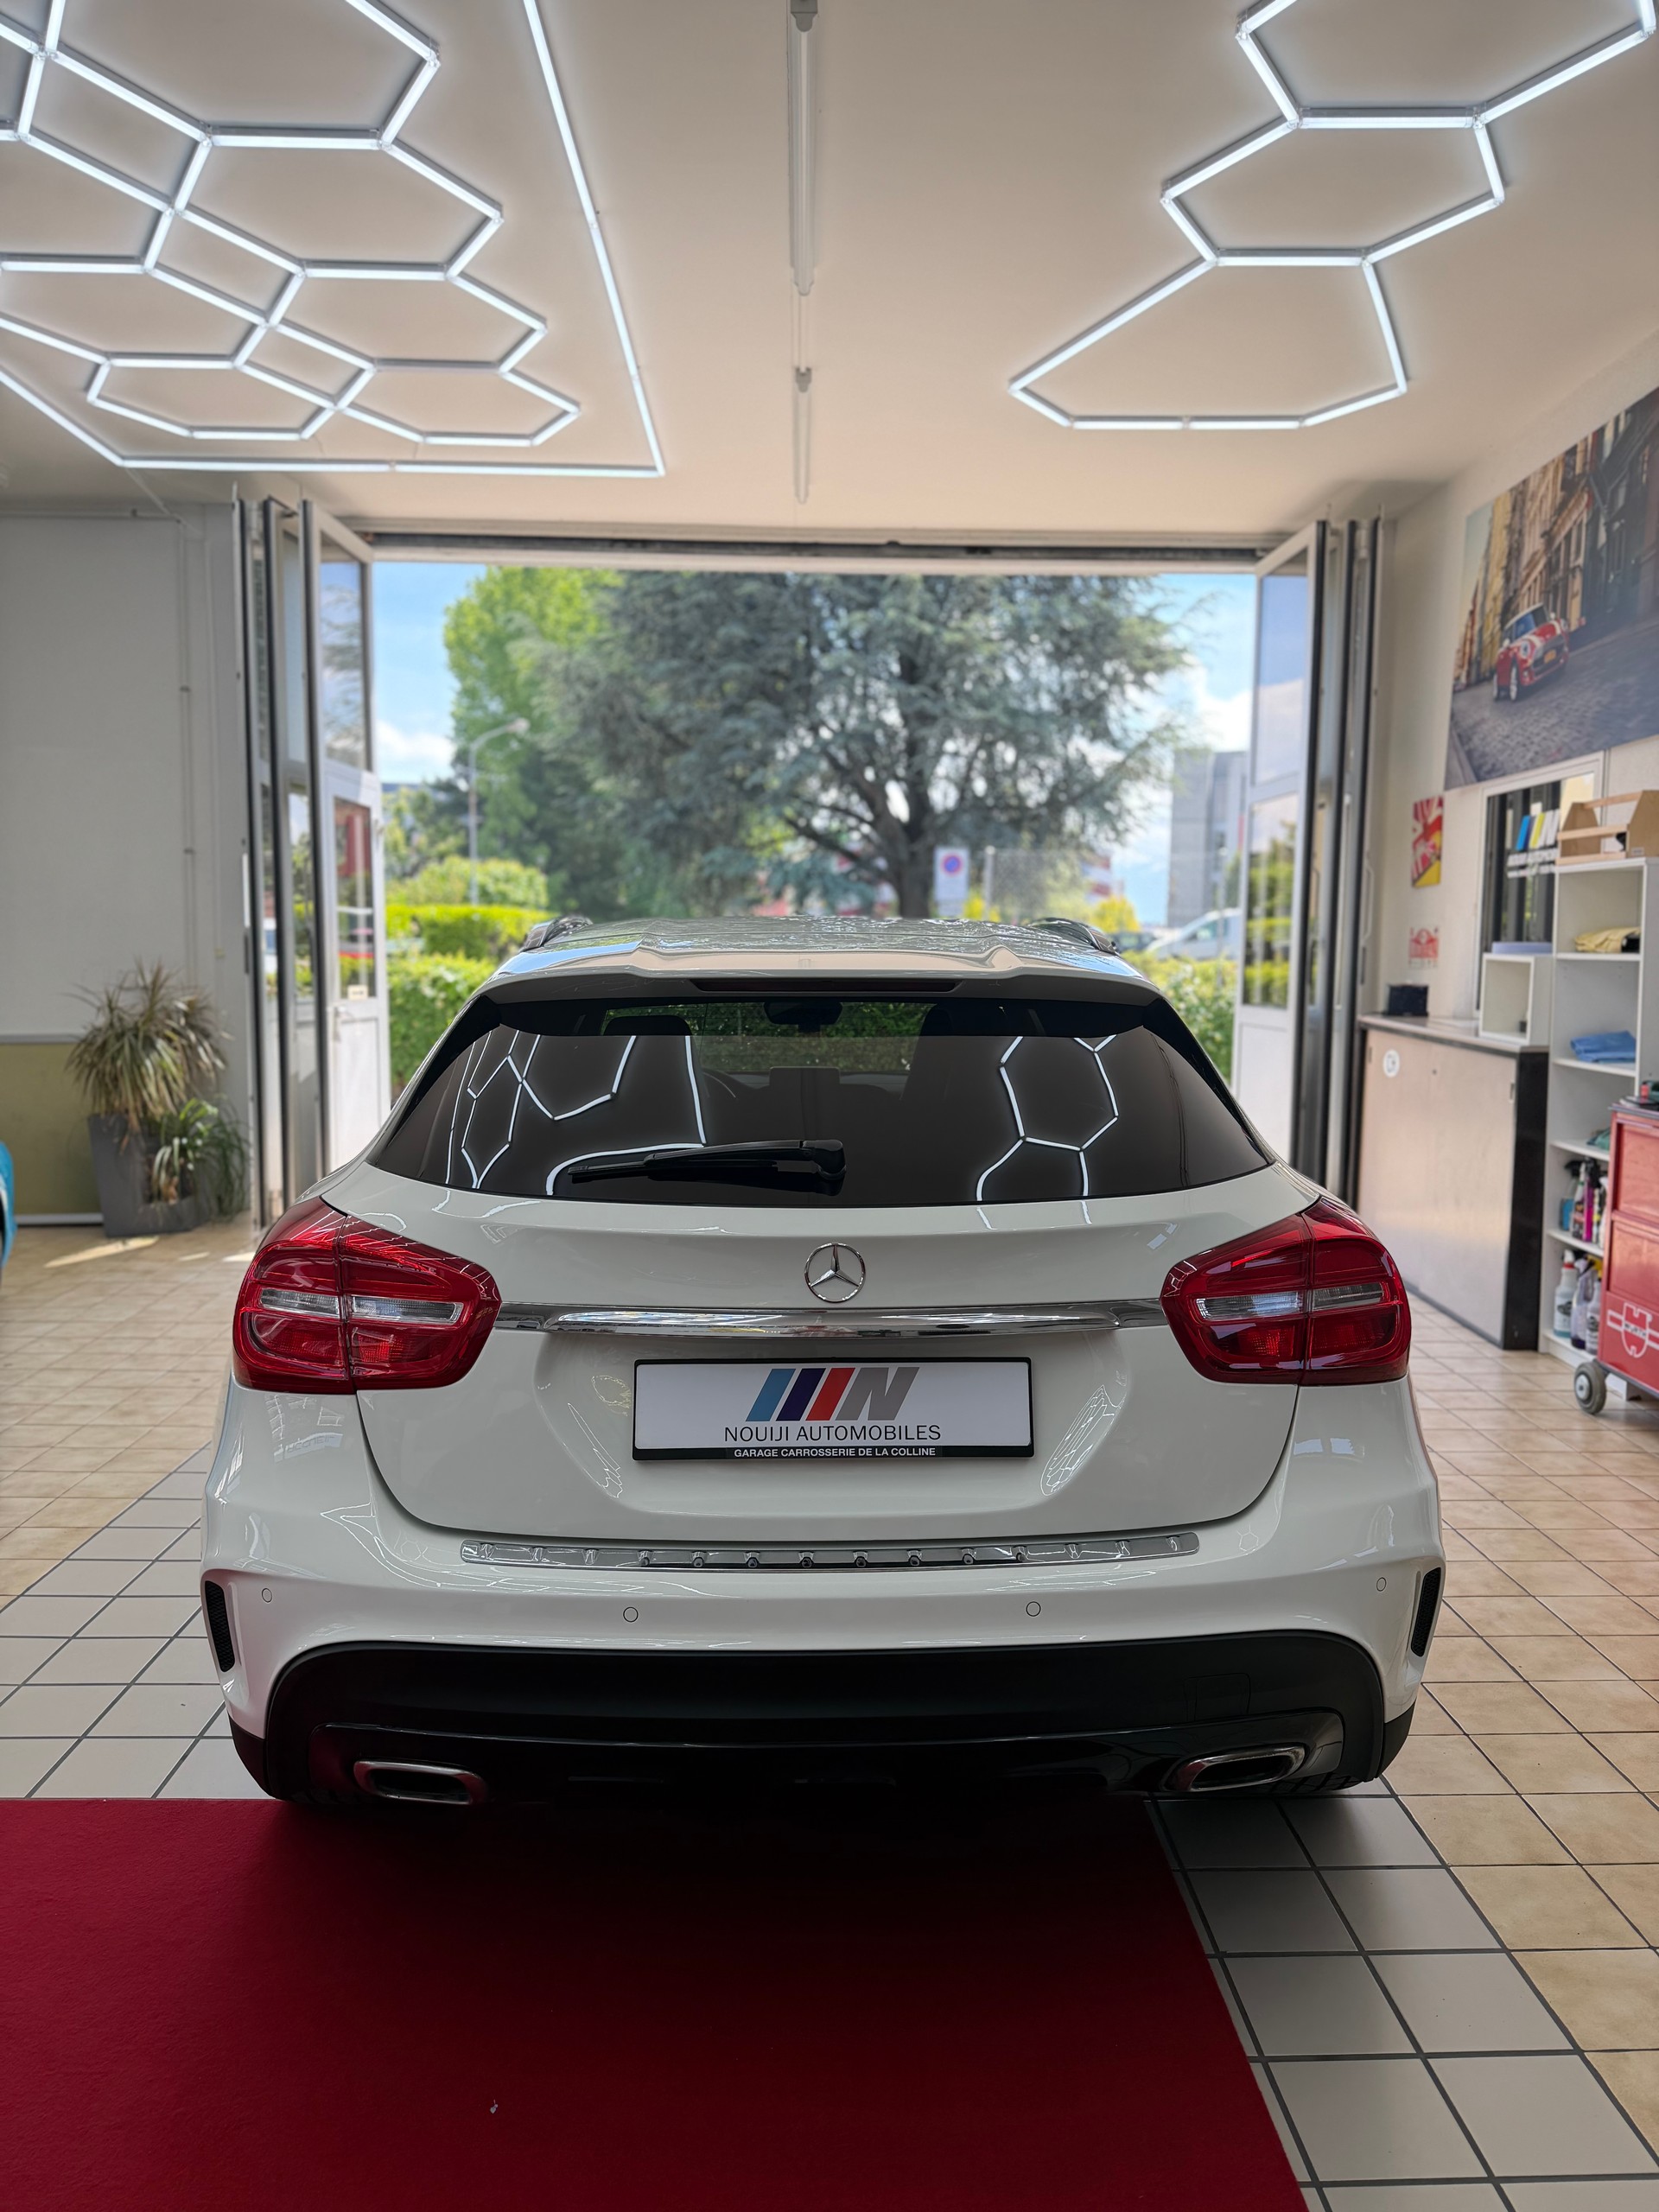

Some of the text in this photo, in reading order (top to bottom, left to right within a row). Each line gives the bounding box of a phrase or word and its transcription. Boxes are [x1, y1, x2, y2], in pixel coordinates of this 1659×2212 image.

[724, 1424, 941, 1442] NOUIJI AUTOMOBILES
[734, 1446, 936, 1458] GARAGE CARROSSERIE DE LA COLLINE
